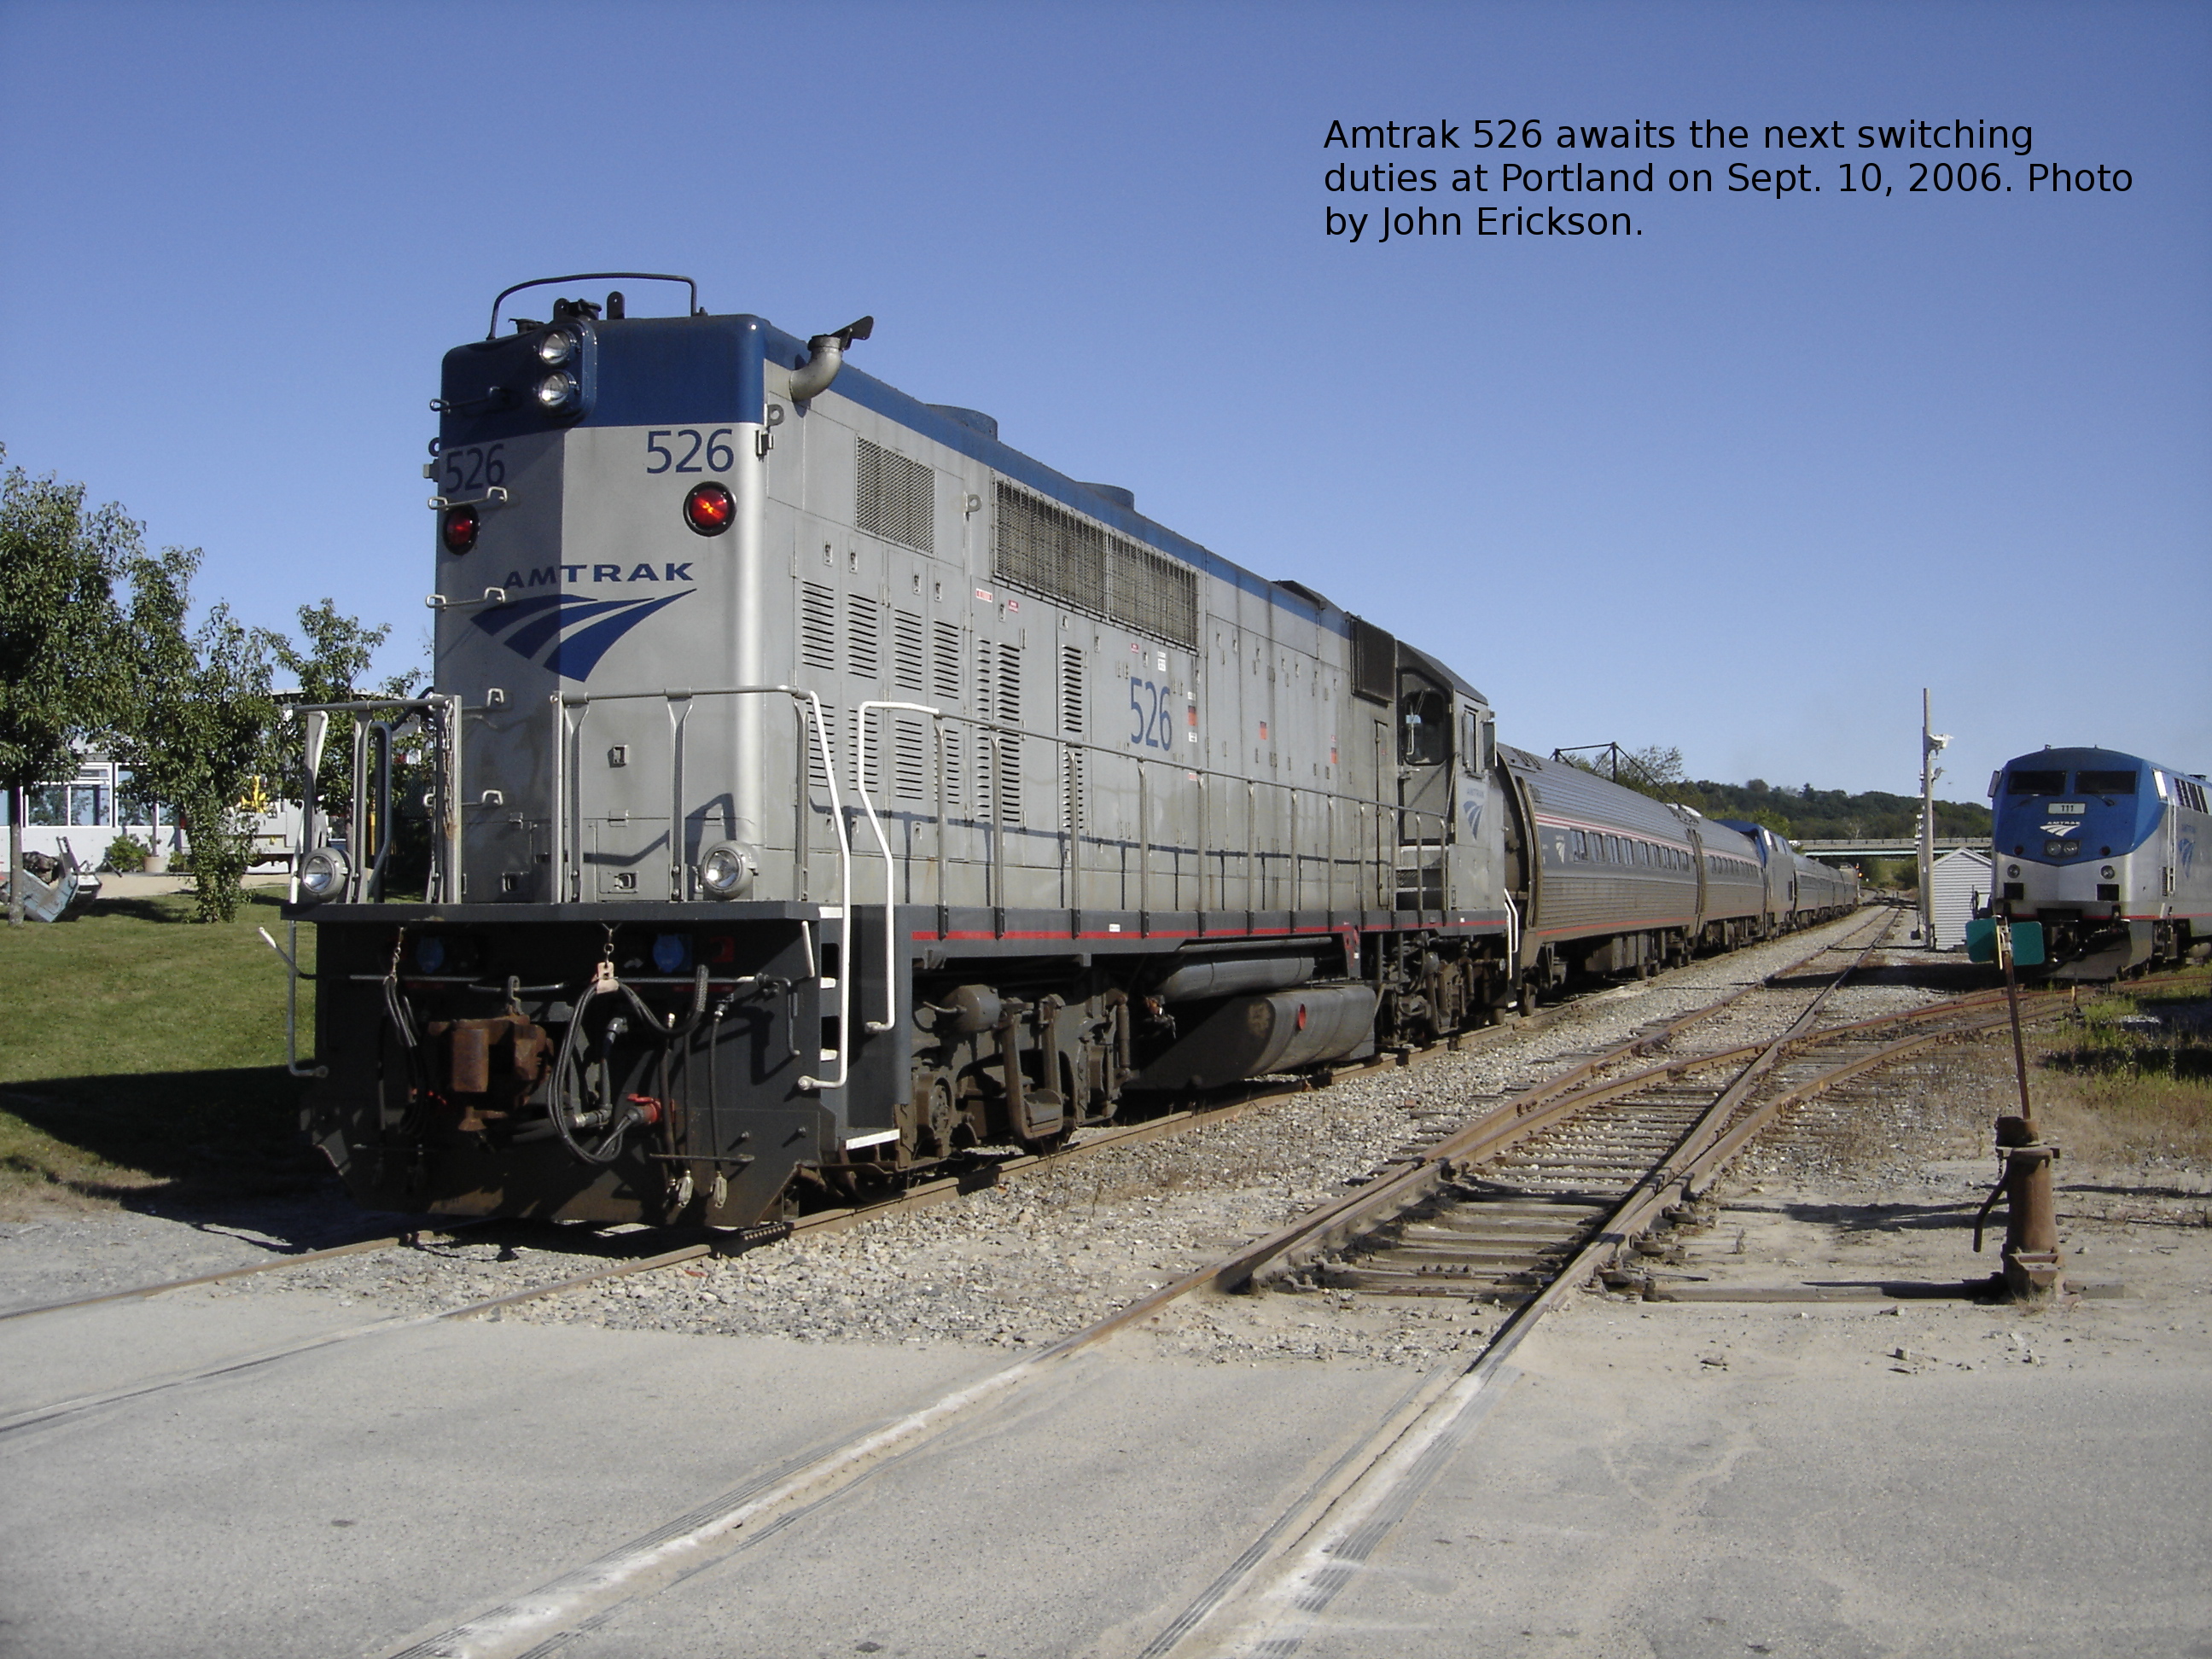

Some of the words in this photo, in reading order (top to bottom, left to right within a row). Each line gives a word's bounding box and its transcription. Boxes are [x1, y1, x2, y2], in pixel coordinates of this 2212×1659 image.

[445, 442, 506, 494] 526
[646, 428, 735, 474] 526
[504, 562, 695, 590] AMTRAK
[1130, 676, 1173, 752] 526
